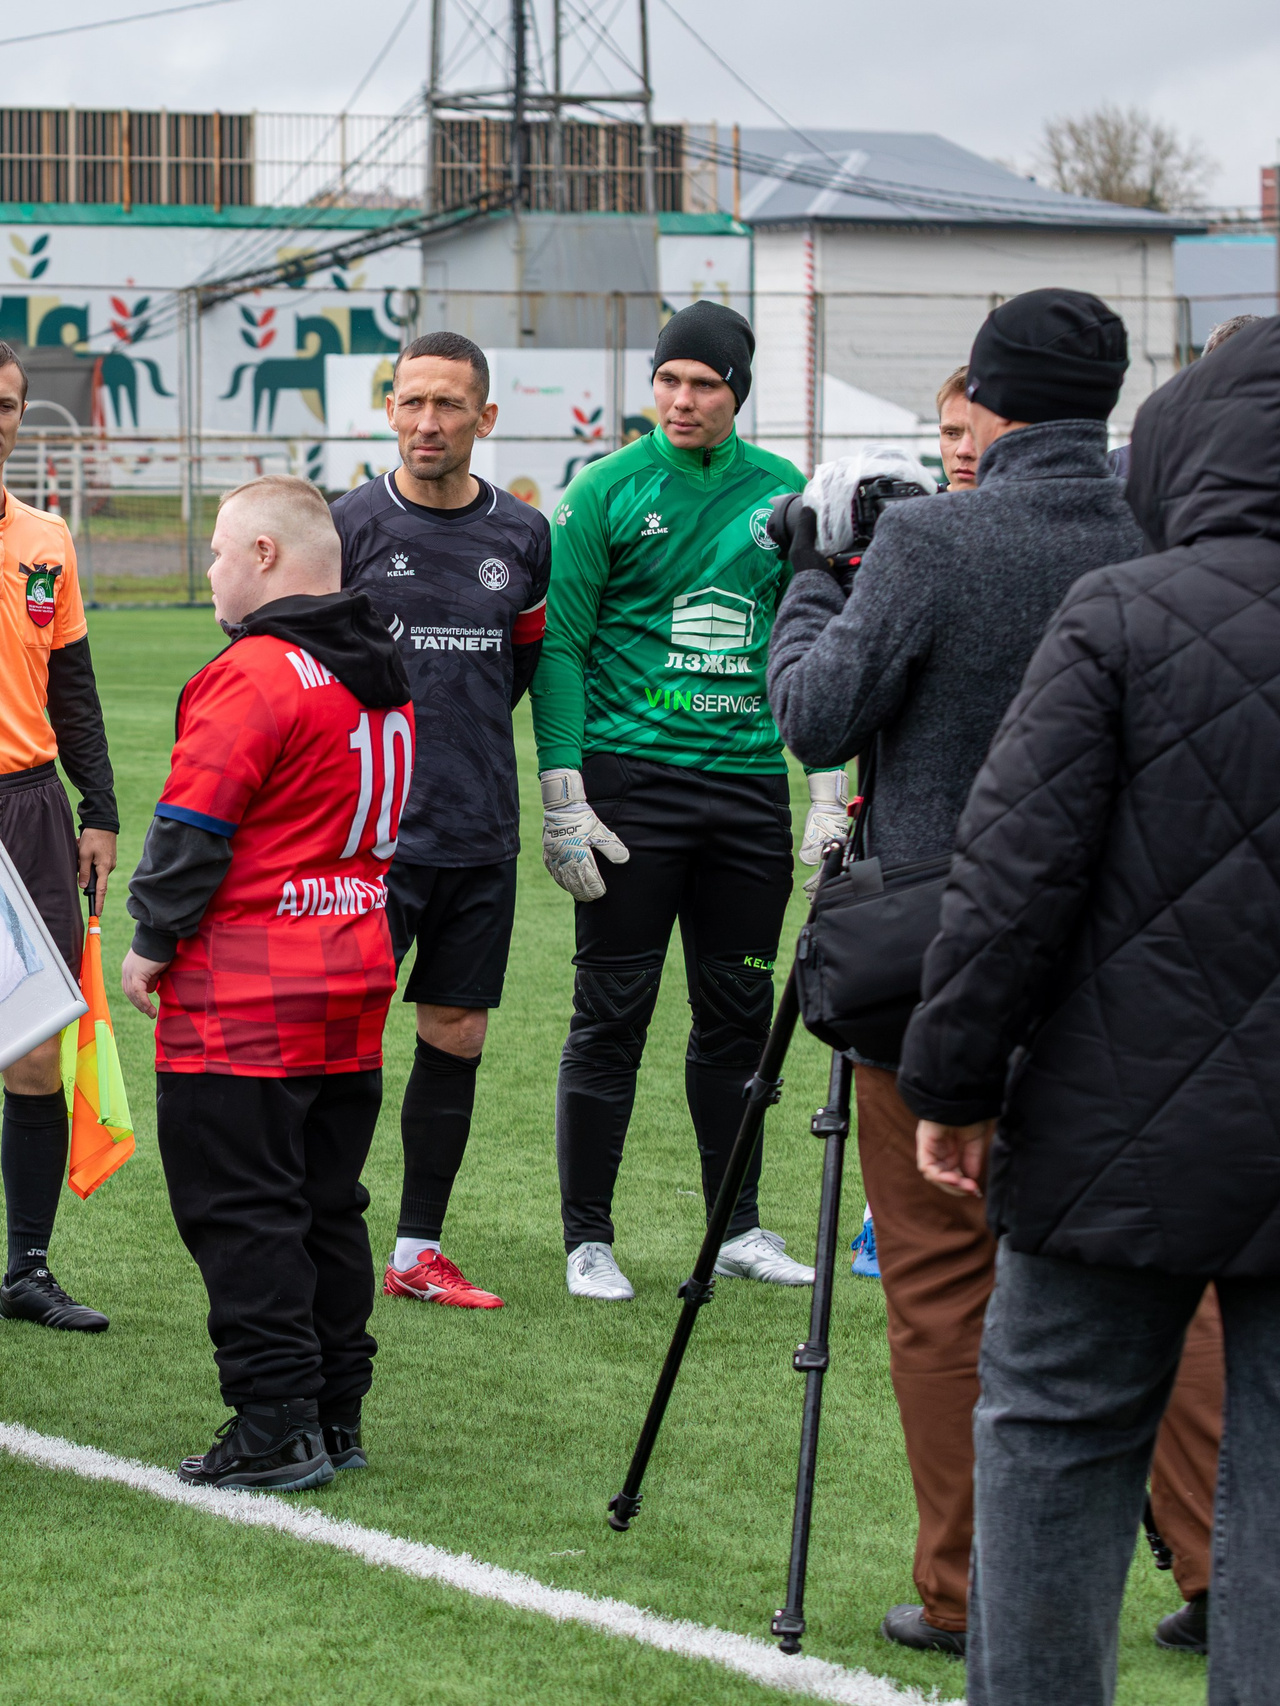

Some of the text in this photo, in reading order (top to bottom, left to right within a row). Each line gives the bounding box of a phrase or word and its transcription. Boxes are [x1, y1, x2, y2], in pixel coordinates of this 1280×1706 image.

[641, 527, 669, 536] KELME
[410, 626, 485, 636] БЛАГОТВОРИТЕЛЬНЫЙ
[410, 635, 502, 652] TATNEFT
[339, 709, 413, 862] 10
